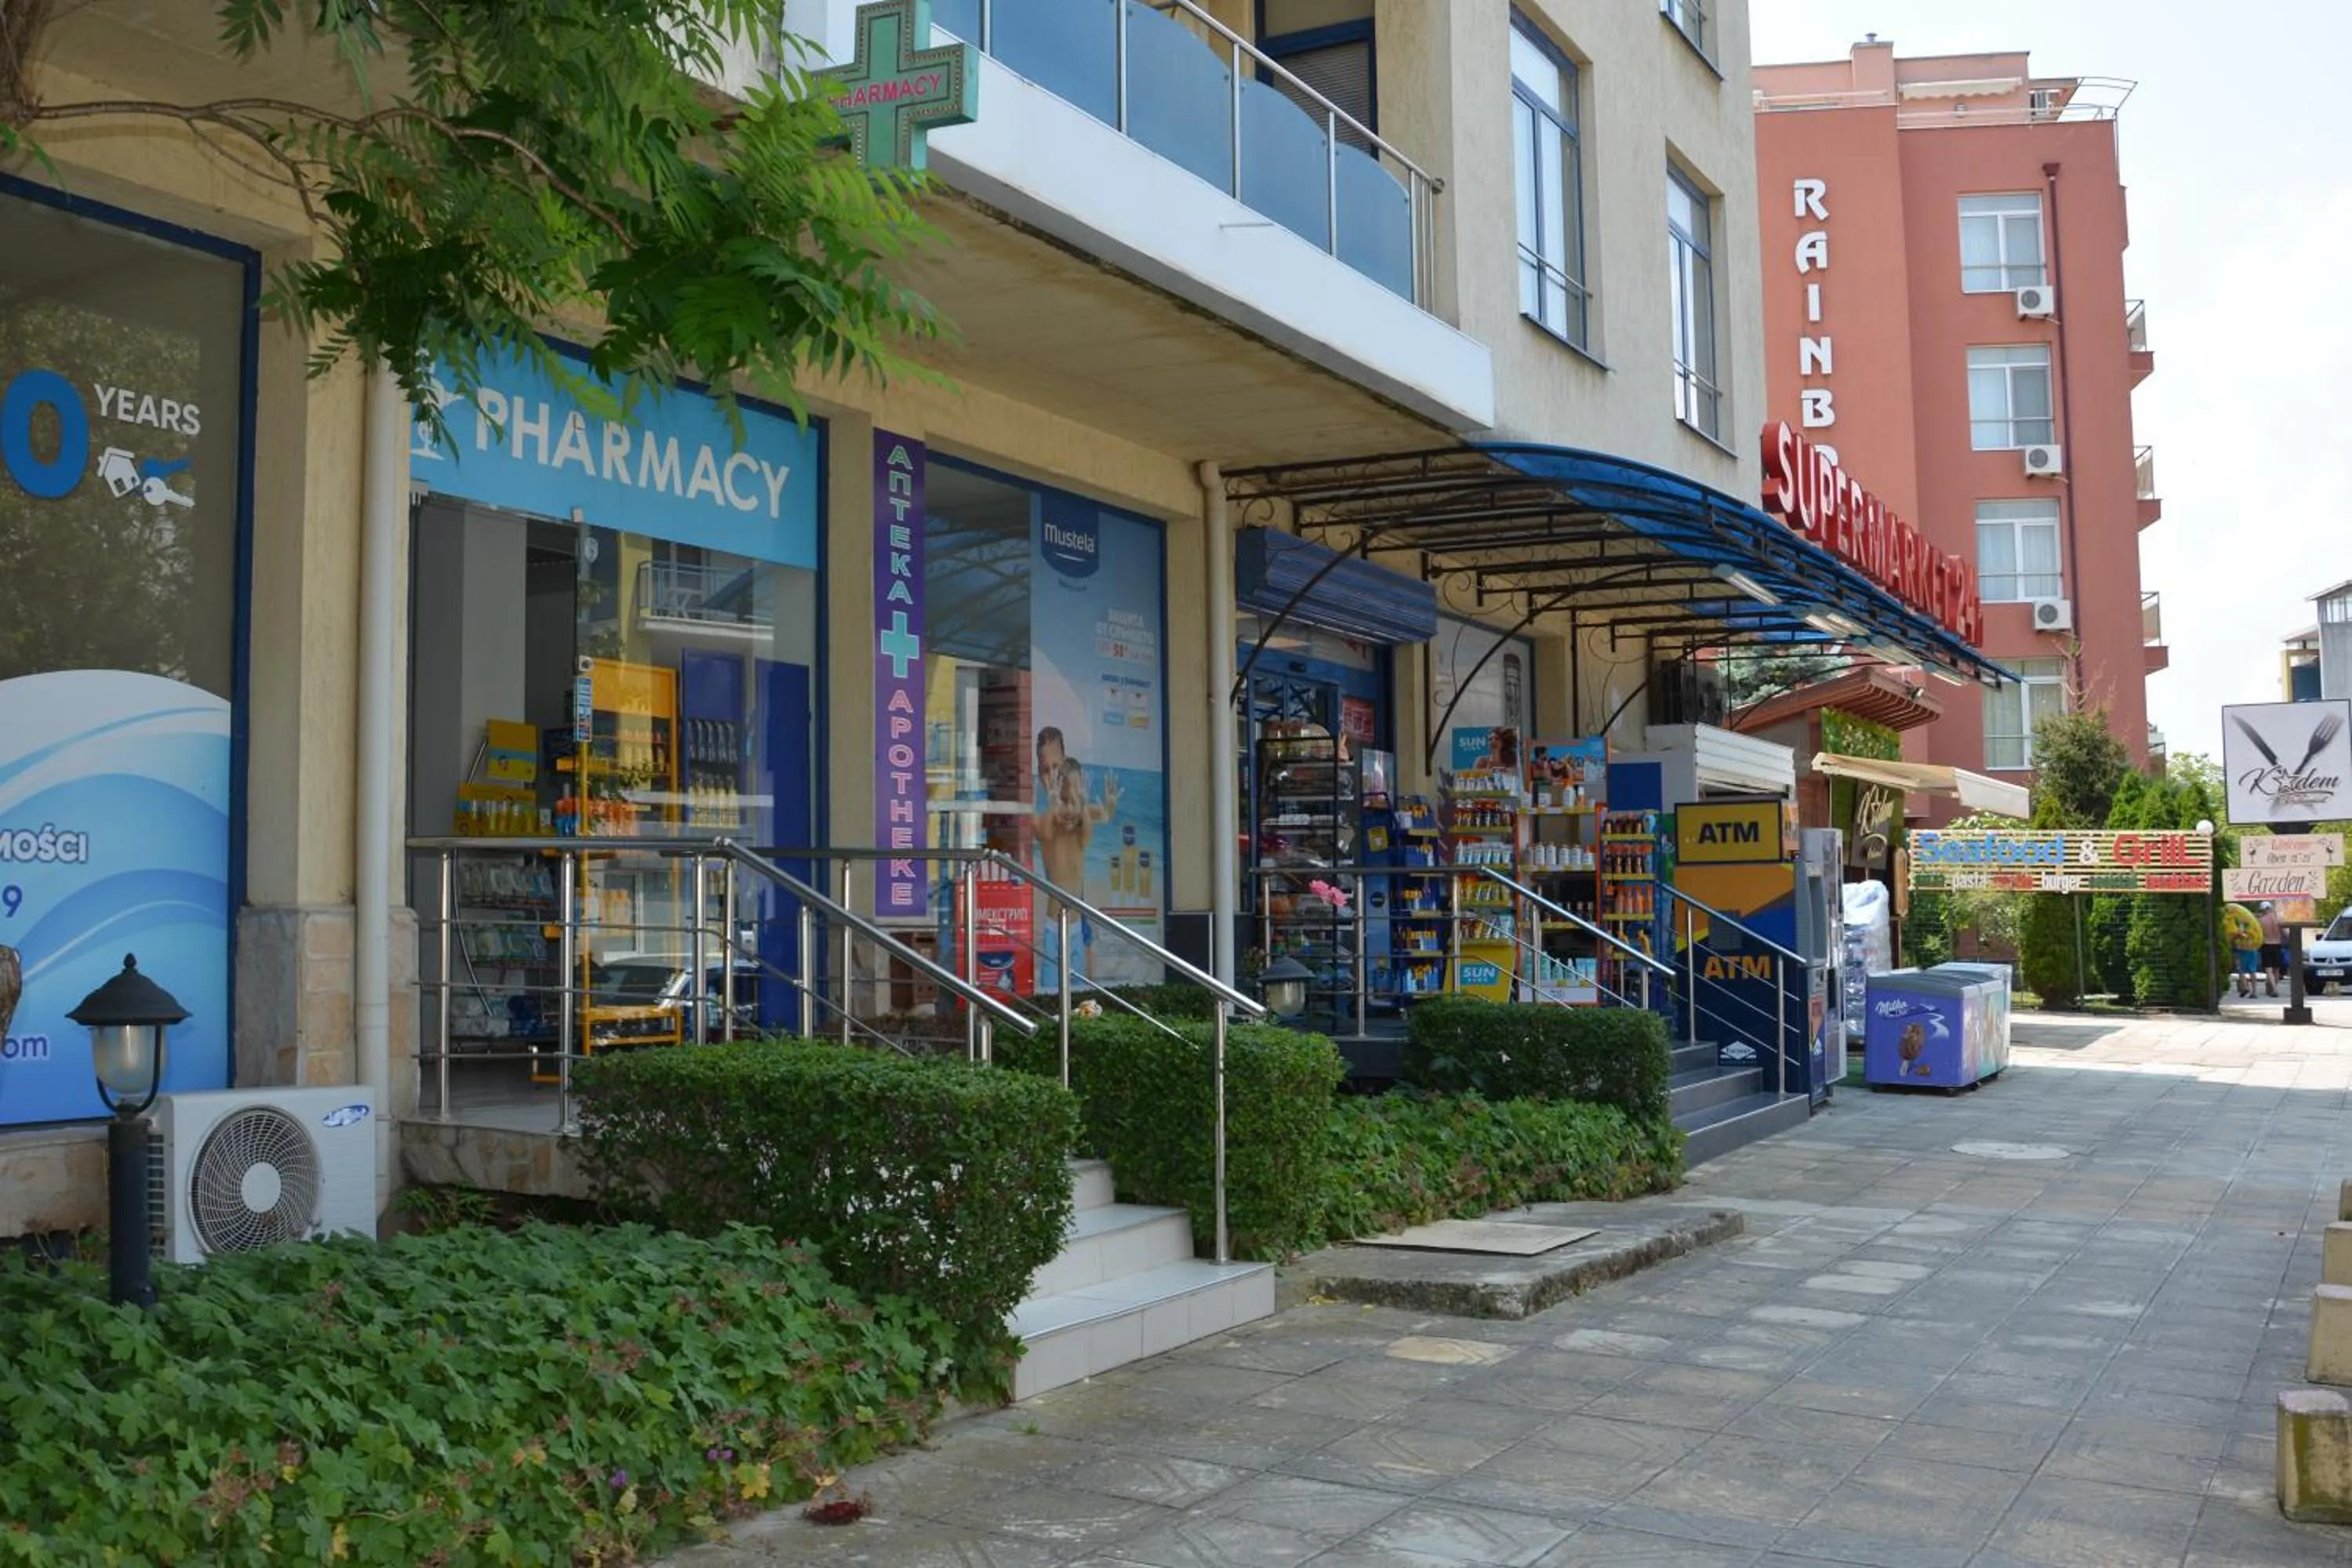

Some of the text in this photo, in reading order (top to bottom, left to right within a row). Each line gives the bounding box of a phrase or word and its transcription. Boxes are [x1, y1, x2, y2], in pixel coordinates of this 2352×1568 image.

[93, 383, 201, 437] YEARS
[475, 387, 790, 519] PHARMACY
[887, 445, 914, 605] АПТЕКА
[1459, 736, 1486, 748] SUN
[887, 689, 916, 907] APOTHEKE
[1698, 821, 1760, 844] ATM
[1917, 831, 2065, 864] Seafood
[2078, 840, 2099, 864] &
[1462, 966, 1497, 978] SUN
[1704, 954, 1773, 980] ATM
